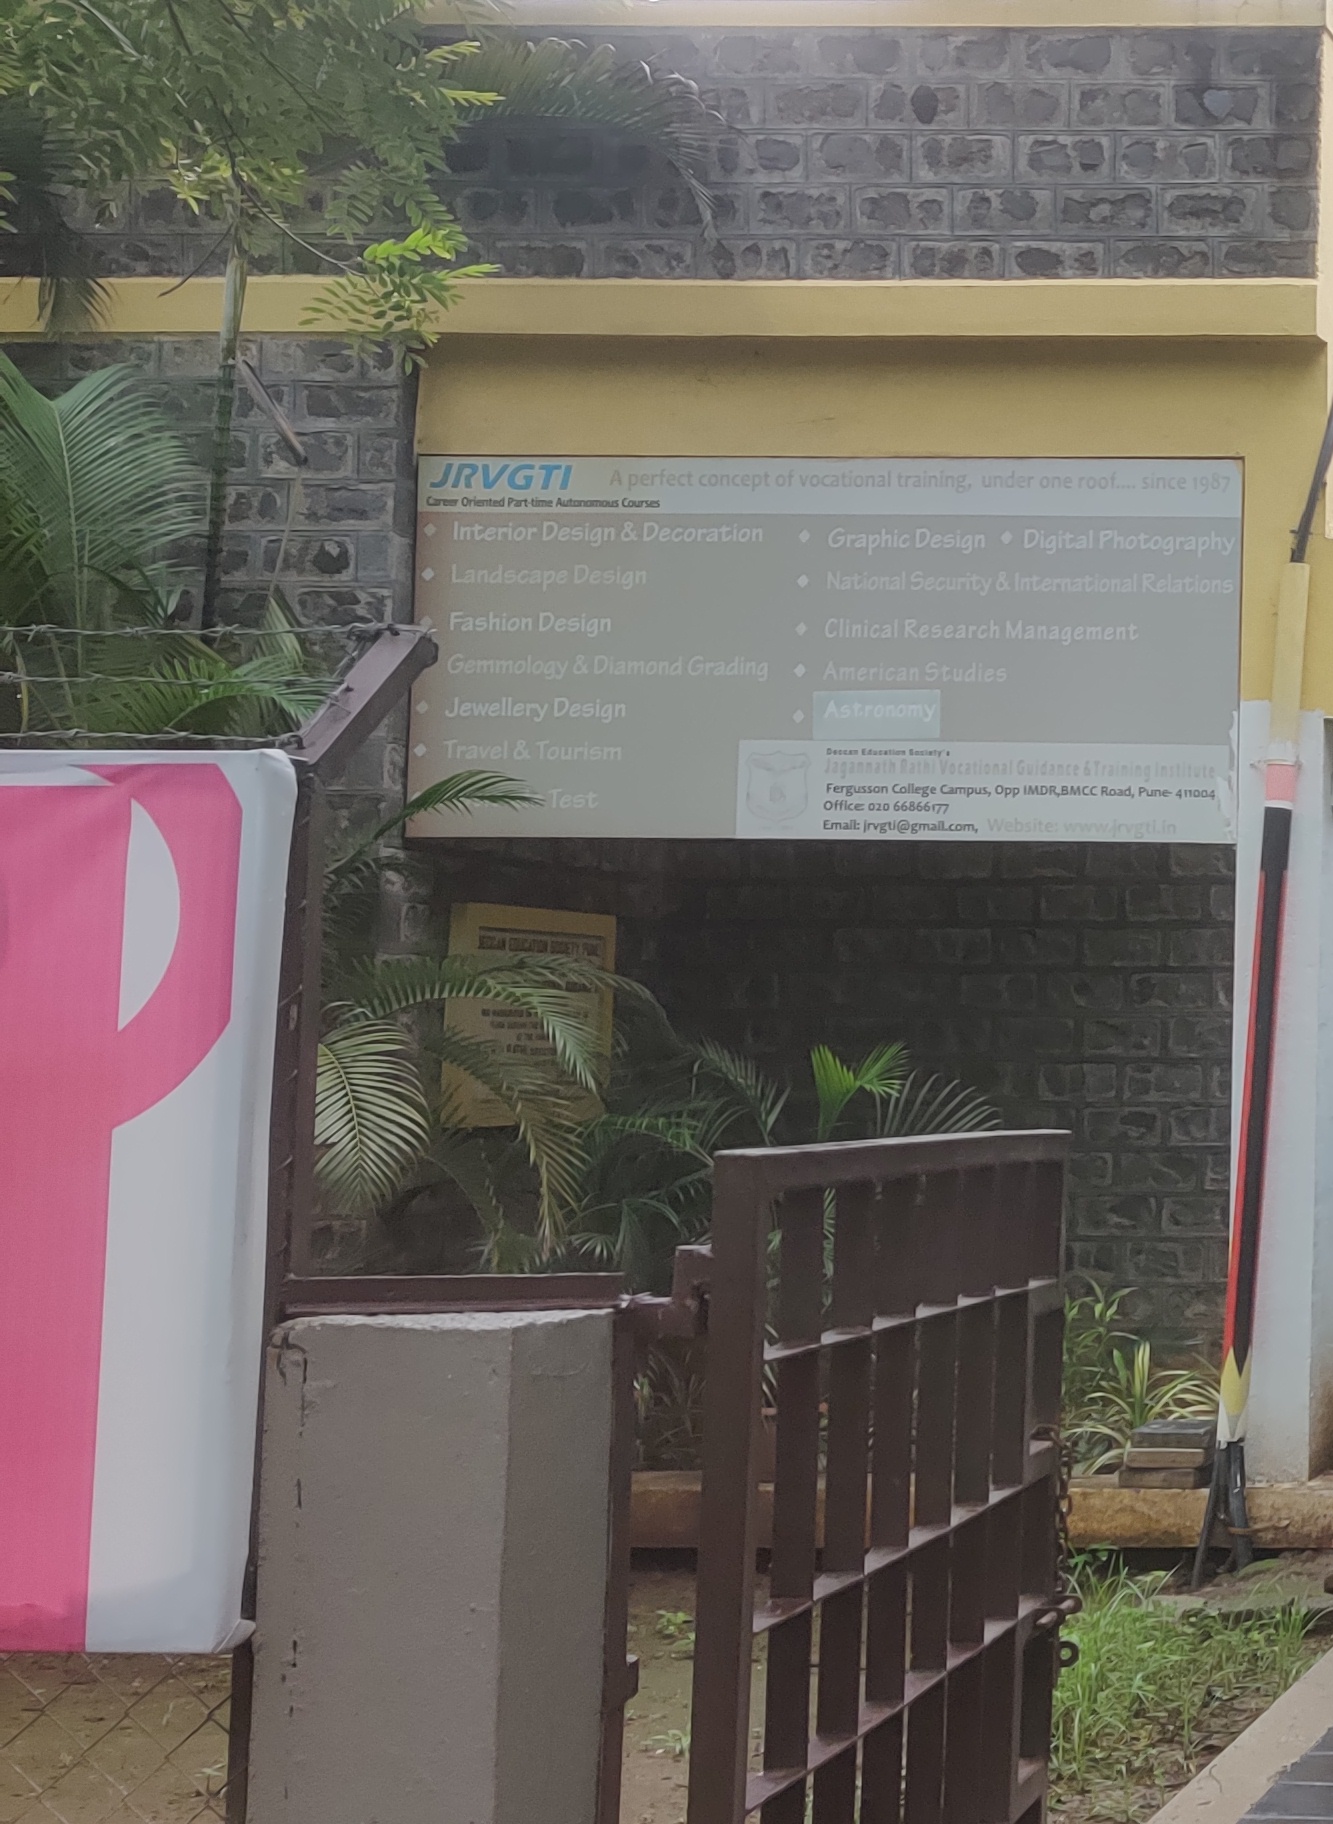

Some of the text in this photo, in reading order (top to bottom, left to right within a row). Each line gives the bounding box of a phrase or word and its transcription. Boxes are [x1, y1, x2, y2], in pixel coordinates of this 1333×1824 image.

[429, 463, 572, 490] JRVGTI
[609, 469, 622, 486] A
[628, 469, 693, 491] perfect
[699, 472, 770, 491] concept
[775, 470, 795, 487] of
[799, 471, 891, 489] vocational
[897, 471, 972, 493] training,
[982, 472, 1034, 488] under
[1039, 475, 1073, 489] one
[1141, 473, 1187, 490] since
[1192, 474, 1231, 493] 1987
[426, 496, 660, 508] Career Oriented Part-time Autonomous Courses
[453, 520, 763, 547] Interior Design & Decoration
[828, 528, 986, 555] Graphic Design
[1023, 529, 1236, 558] Digital Photography
[451, 563, 647, 591] Landscape Design
[826, 571, 1234, 596] National Security & International Relations
[449, 612, 612, 637] Fashion Design
[824, 619, 1139, 646] Clinical Research Management
[447, 654, 768, 681] Gemmology & Diamond Grading
[823, 660, 1007, 683] American Studies
[445, 698, 626, 723] Jewellery Design
[824, 700, 936, 722] Astronomy
[444, 740, 622, 761] Travel & Tourism
[824, 757, 896, 779] Jagannath
[900, 759, 935, 775] Rathi
[939, 759, 1012, 776] Vocational
[1016, 760, 1079, 777] Guidance
[1155, 762, 1215, 779] Institute
[549, 789, 600, 810] Test
[826, 783, 888, 797] Fergusson
[892, 783, 937, 798] College
[940, 784, 992, 798] Campus,
[995, 785, 1020, 798] Opp
[1101, 786, 1135, 799] Road,
[1175, 788, 1216, 800] 411004
[868, 803, 890, 812] 020
[893, 801, 950, 815] 66866177
[823, 820, 861, 831] Email:
[987, 817, 1177, 839] Website: www.jrvgti.in
